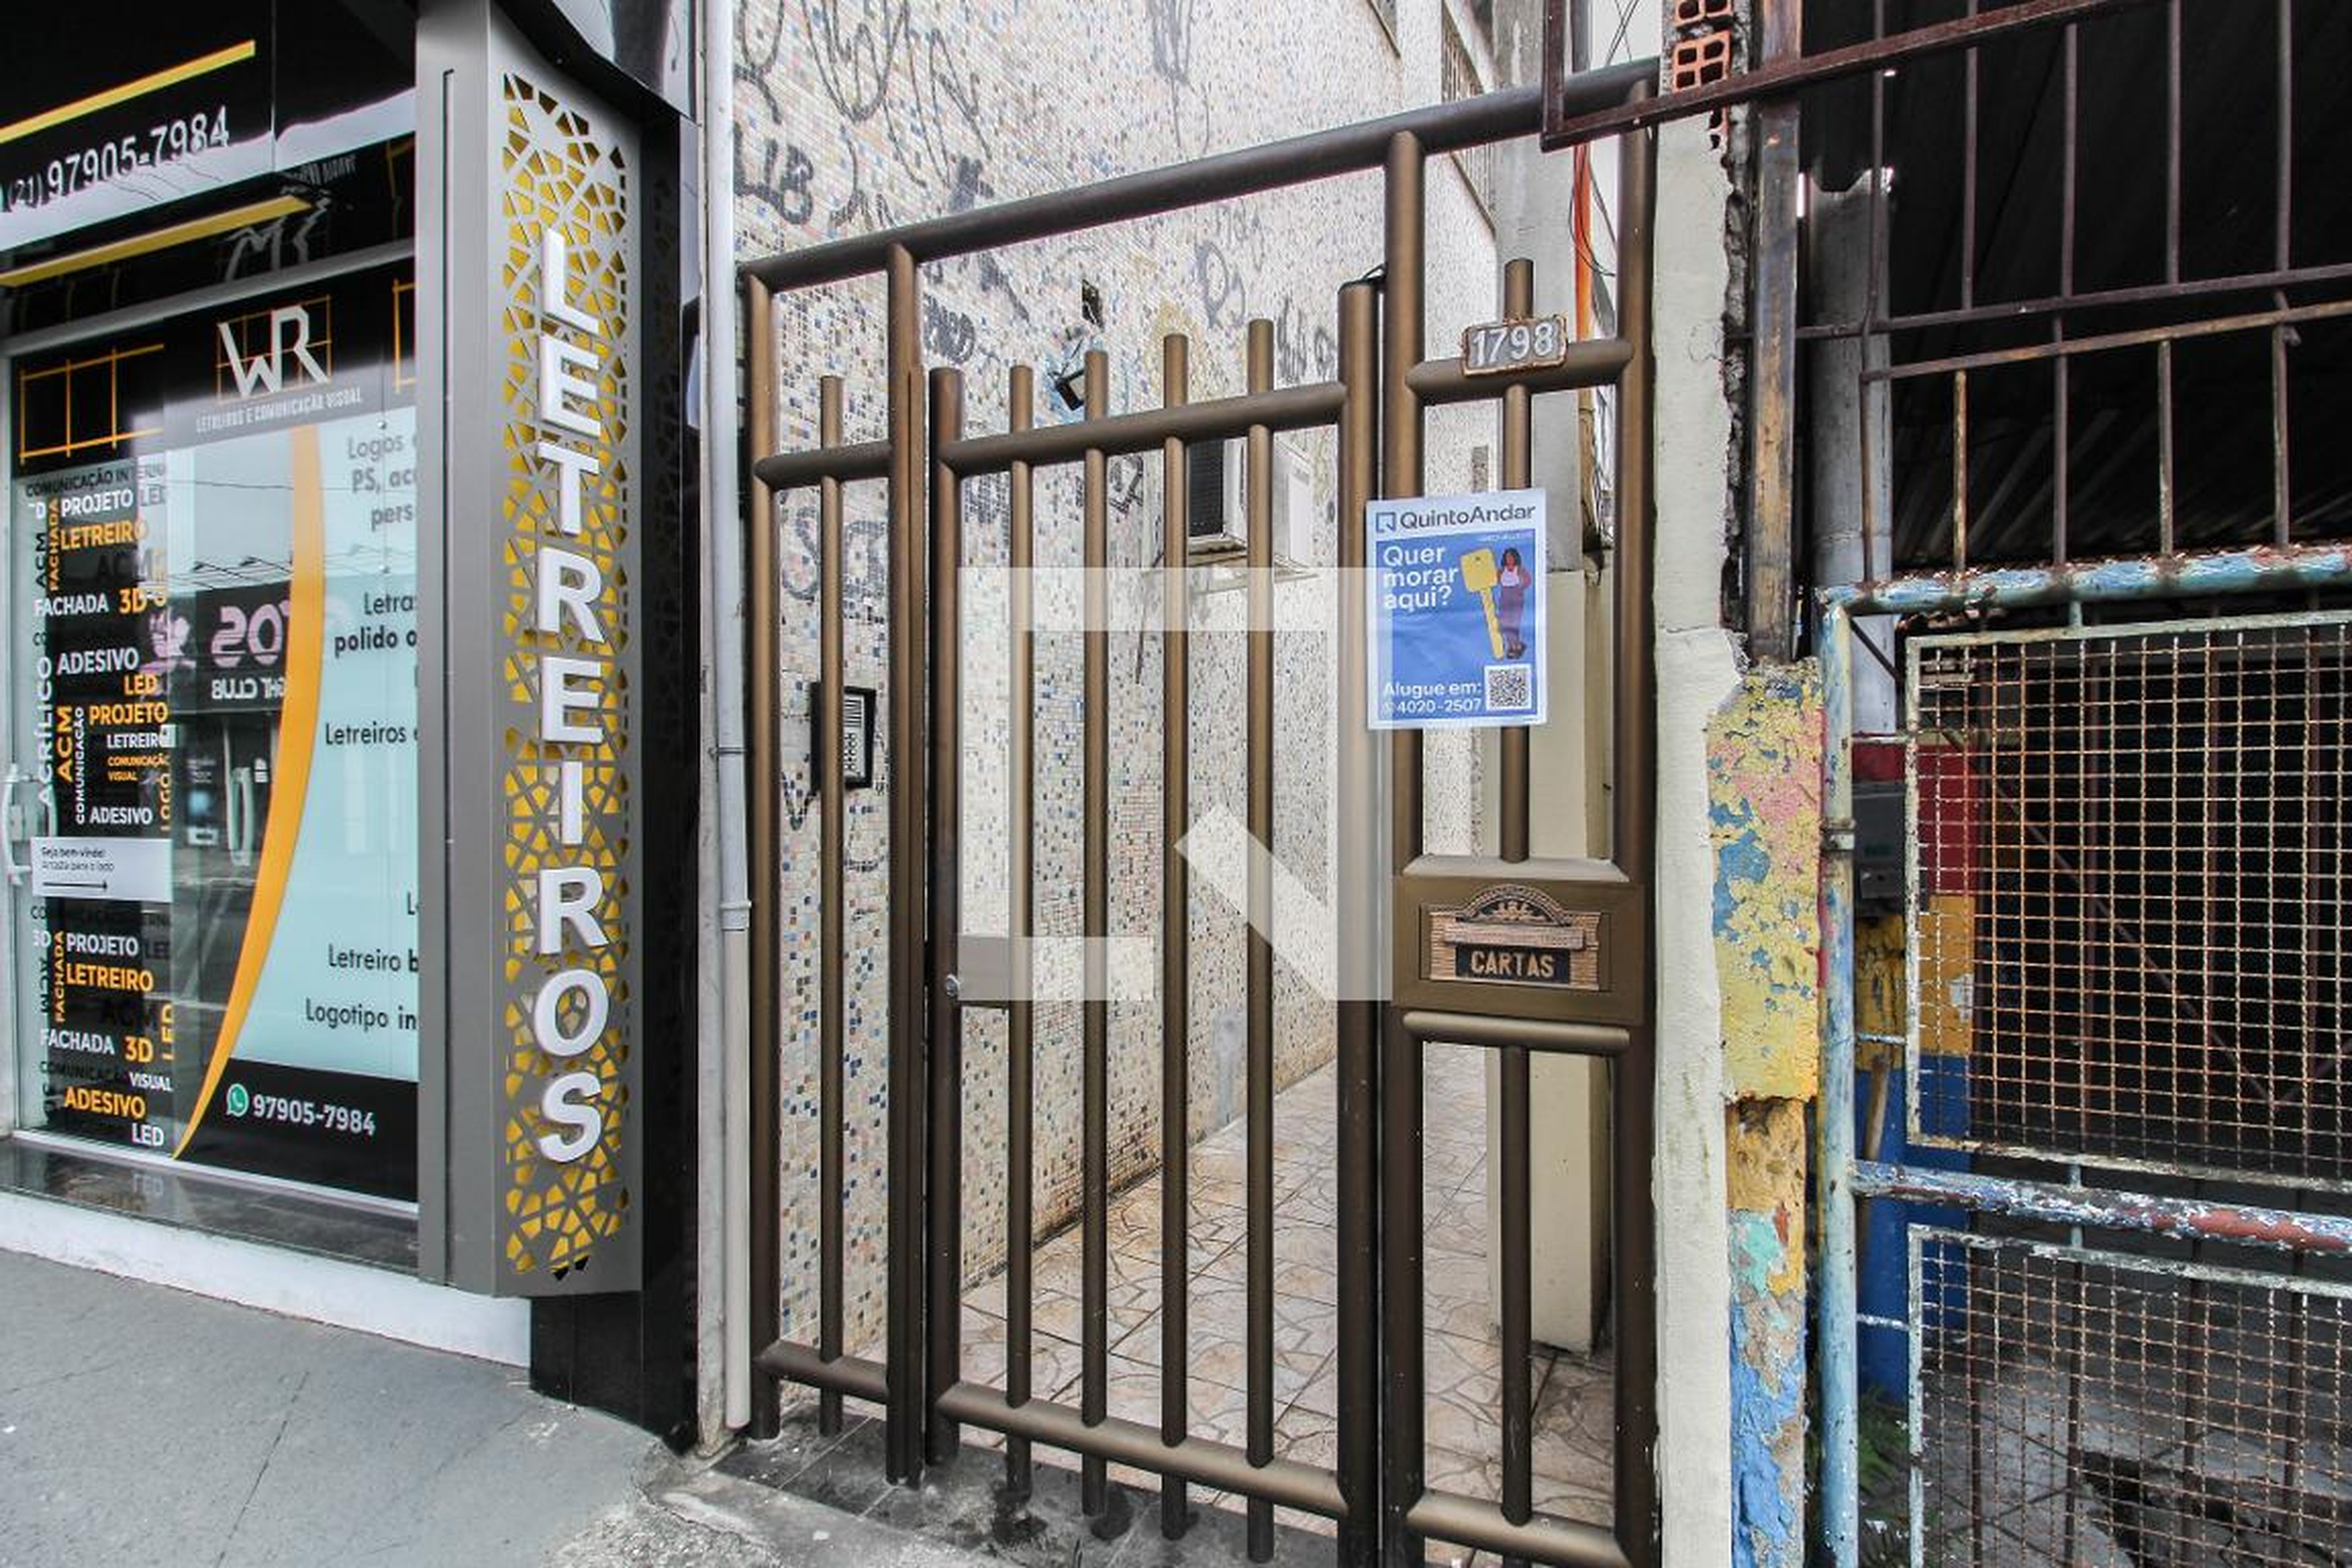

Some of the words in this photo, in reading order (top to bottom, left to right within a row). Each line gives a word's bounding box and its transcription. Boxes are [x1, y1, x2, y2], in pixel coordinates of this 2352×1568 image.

[47, 104, 230, 196] 97905-7984
[217, 304, 329, 398] WR
[1472, 323, 1555, 366] 1798
[347, 435, 404, 462] Logos
[352, 467, 381, 494] PS,
[390, 468, 417, 488] ac
[61, 488, 134, 518] PROJETO
[1400, 504, 1536, 530] QuintoAndar
[371, 503, 413, 532] pers
[60, 519, 147, 551] LETREIRO
[1383, 545, 1446, 567] Quer
[1384, 567, 1458, 588] morar
[32, 592, 109, 617] FACHADA
[119, 587, 148, 615] 3D
[364, 592, 417, 615] Letra
[1384, 585, 1453, 613] aqui?
[334, 624, 398, 660] polido
[57, 647, 139, 676] ADESIVO
[124, 673, 158, 696] LED
[535, 228, 609, 1164] LETREIROS
[1383, 682, 1445, 699] Alugue
[1449, 681, 1482, 695] em:
[89, 702, 168, 725] PROJETO
[1397, 698, 1482, 714] 4020-2507
[56, 705, 73, 783] ACM
[326, 720, 407, 745] Letreiros
[73, 706, 85, 824] COMUNICAÇÃO
[107, 771, 138, 782] VISUAL
[89, 806, 153, 826] ADESIVO
[407, 891, 419, 916] L
[66, 932, 139, 957] PROJETO
[328, 943, 401, 973] Letreiro
[66, 963, 154, 992] LETREIRO
[1470, 950, 1555, 978] CARTAS
[306, 996, 390, 1033] Logotipo
[40, 1028, 115, 1055] FACHADA
[124, 1036, 154, 1063] 3D
[129, 1071, 174, 1092] VISUAL
[64, 1085, 146, 1119] ADESIVO
[252, 1093, 375, 1137] 97905-7984
[131, 1122, 165, 1147] LED
